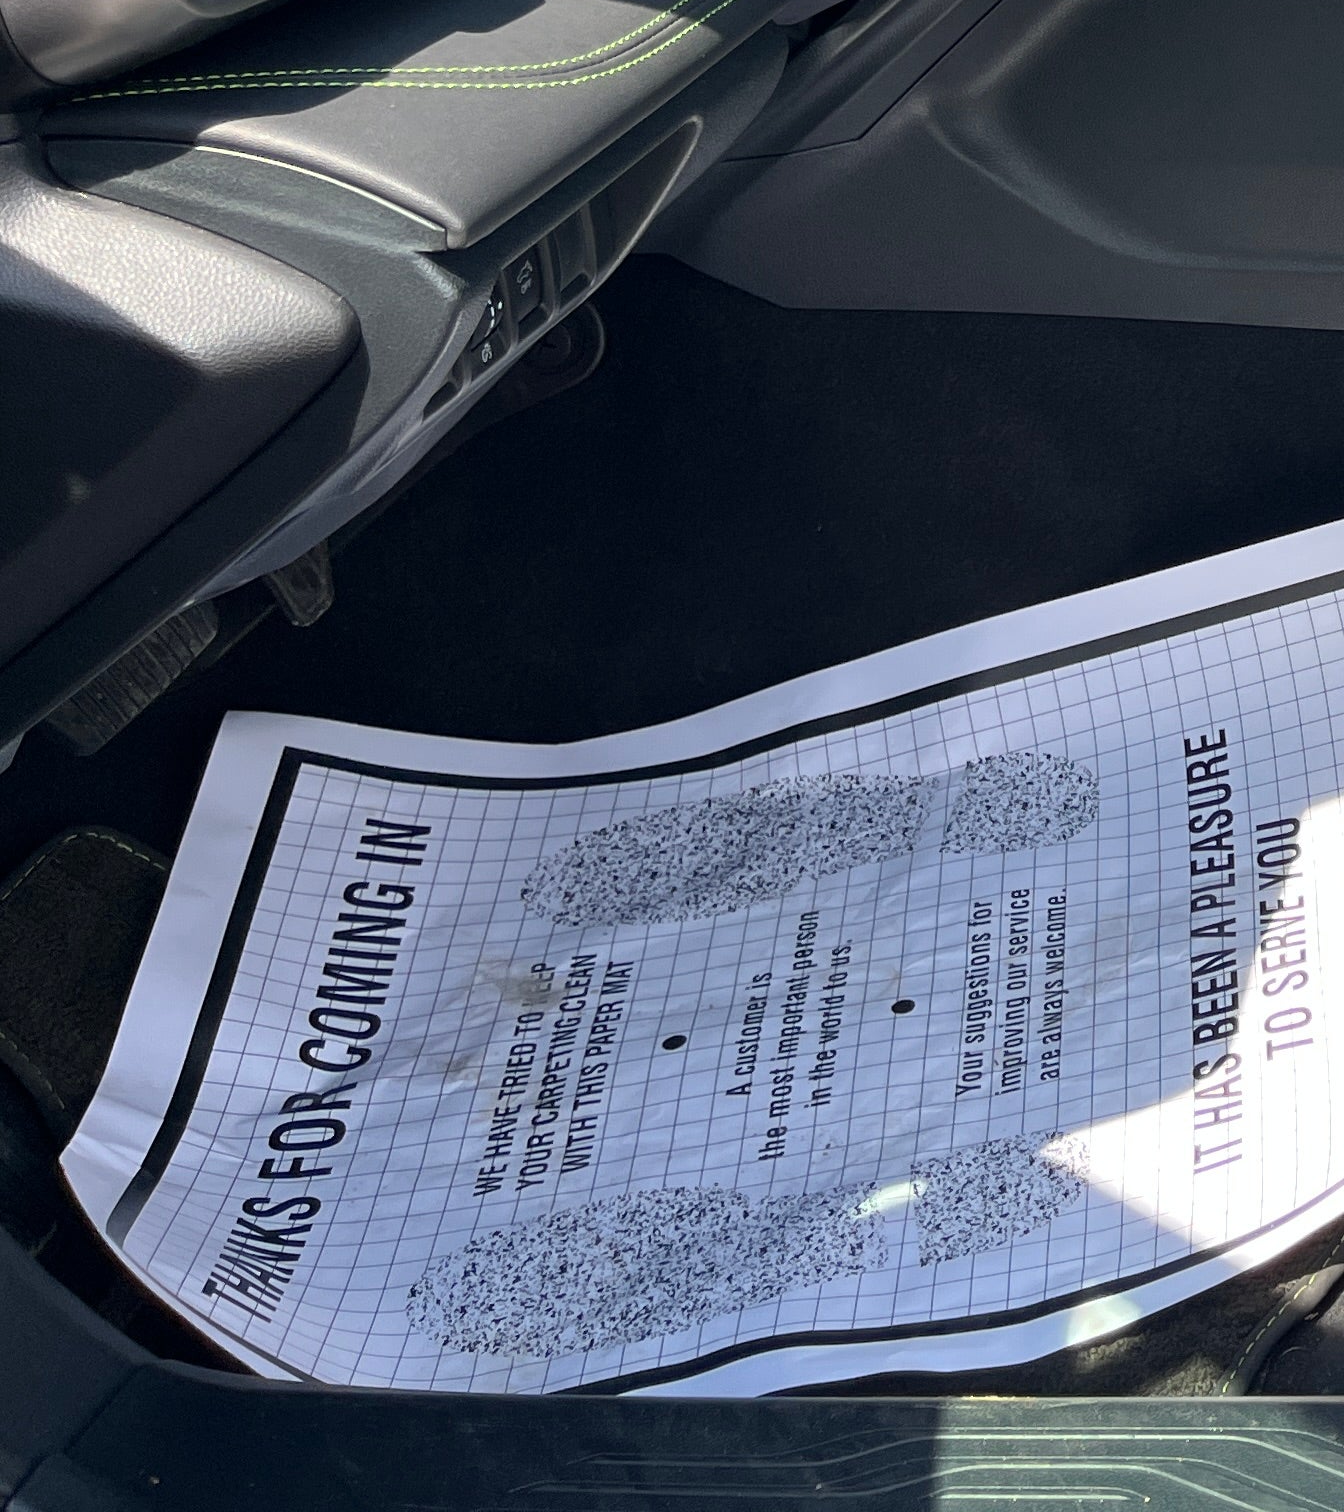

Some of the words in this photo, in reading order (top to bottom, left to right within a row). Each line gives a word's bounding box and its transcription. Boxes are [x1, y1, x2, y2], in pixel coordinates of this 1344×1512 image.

[355, 817, 432, 866] IN
[1183, 728, 1236, 913] PLEASURE
[1255, 816, 1302, 891] YOU
[791, 910, 820, 969] person
[967, 900, 992, 926] for
[1004, 888, 1030, 955] service
[1040, 888, 1066, 975] welcome.
[1189, 916, 1236, 938] A
[830, 939, 852, 966] us.
[1259, 895, 1308, 996] SERVE
[297, 877, 416, 1072] COMING
[559, 953, 598, 1011] CLEAN
[600, 960, 634, 995] MAT
[745, 971, 772, 989] is
[822, 972, 848, 990] to
[965, 932, 992, 1043] suggestions
[1007, 962, 1026, 990] our
[1190, 947, 1238, 1043] BEEN
[513, 1011, 544, 1036] TO
[584, 999, 624, 1057] PAPER
[734, 994, 767, 1075] customer
[770, 974, 810, 1060] important
[819, 995, 844, 1044] world
[1037, 979, 1068, 1044] always
[1264, 1007, 1313, 1060] TO
[497, 1042, 536, 1100] TRIED
[531, 1016, 581, 1126] CARPETING
[808, 1049, 837, 1080] the
[955, 1050, 983, 1097] Your
[995, 996, 1029, 1095] improving
[1040, 1049, 1060, 1080] are
[572, 1062, 609, 1110] THIS
[725, 1082, 752, 1095] A
[768, 1066, 794, 1117] most
[804, 1086, 832, 1108] in
[1192, 1052, 1242, 1129] HAS
[257, 1080, 357, 1178] FOR
[483, 1103, 522, 1158] HAVE
[560, 1115, 598, 1173] WITH
[758, 1125, 787, 1160] the
[1193, 1137, 1242, 1174] IT
[472, 1163, 507, 1196] WE
[515, 1131, 555, 1191] YOUR
[202, 1196, 321, 1324] THANKS
